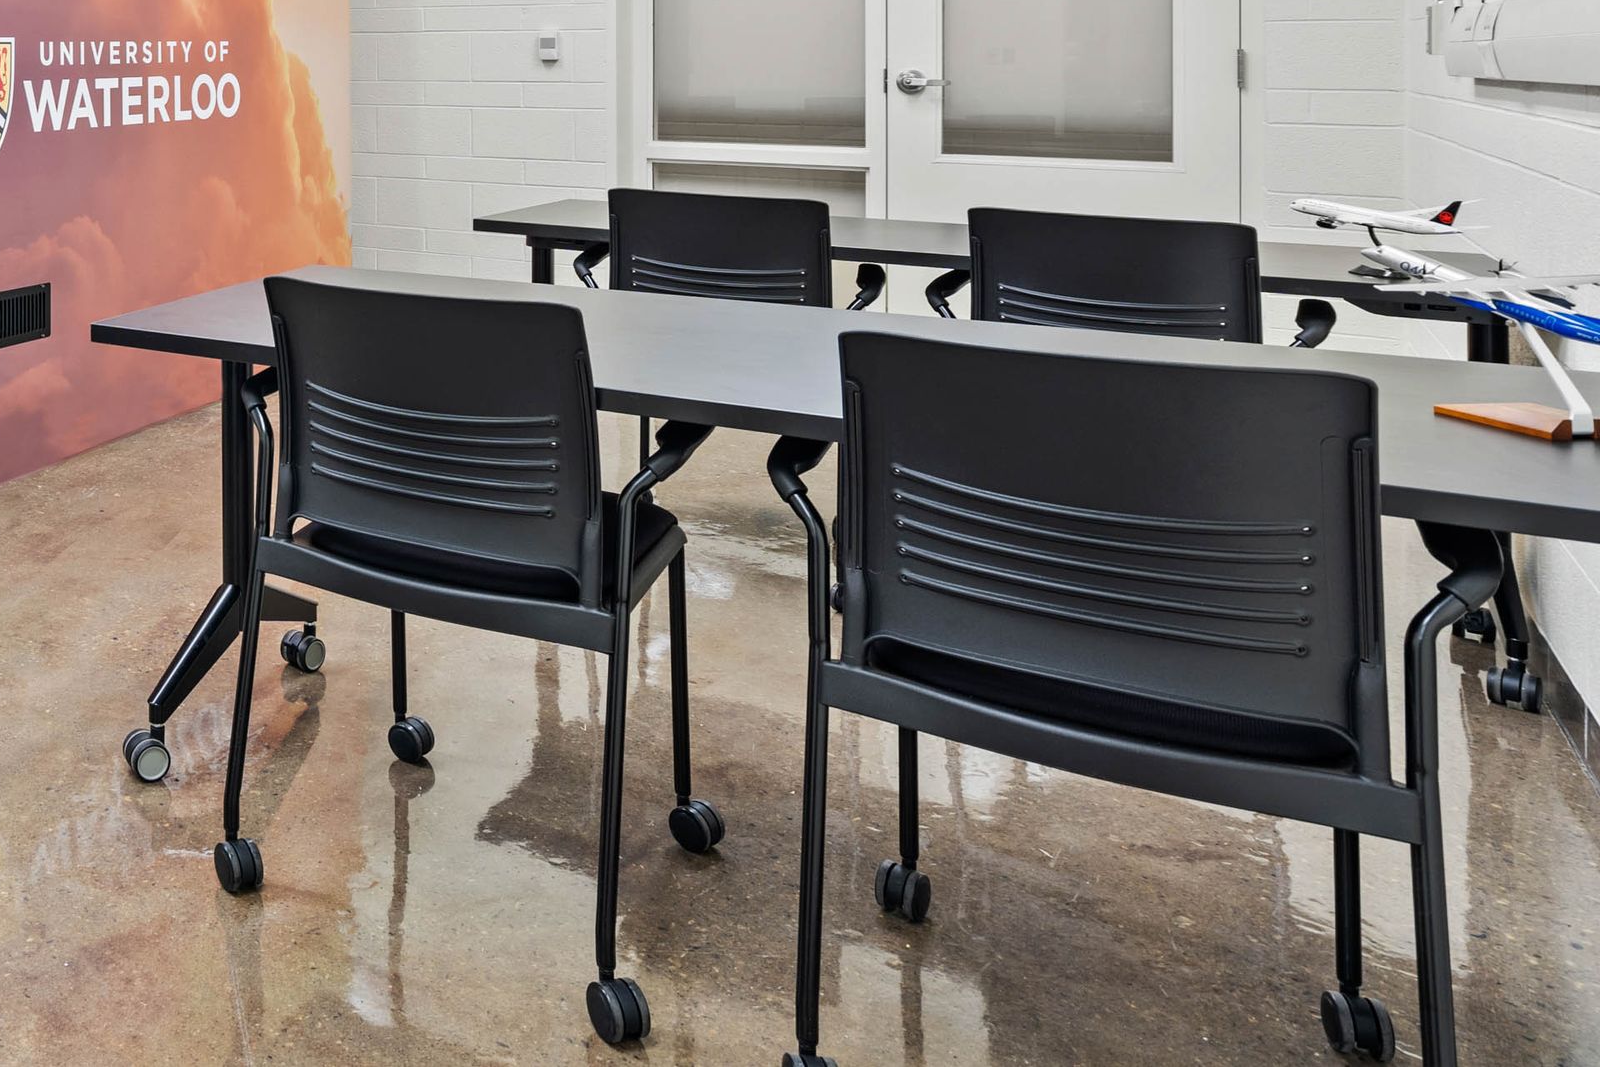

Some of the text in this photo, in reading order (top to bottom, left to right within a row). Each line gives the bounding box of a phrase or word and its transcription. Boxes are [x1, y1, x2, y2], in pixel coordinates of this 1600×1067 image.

[39, 40, 230, 66] UNIVERSITY OF
[23, 72, 241, 133] WATERLOO
